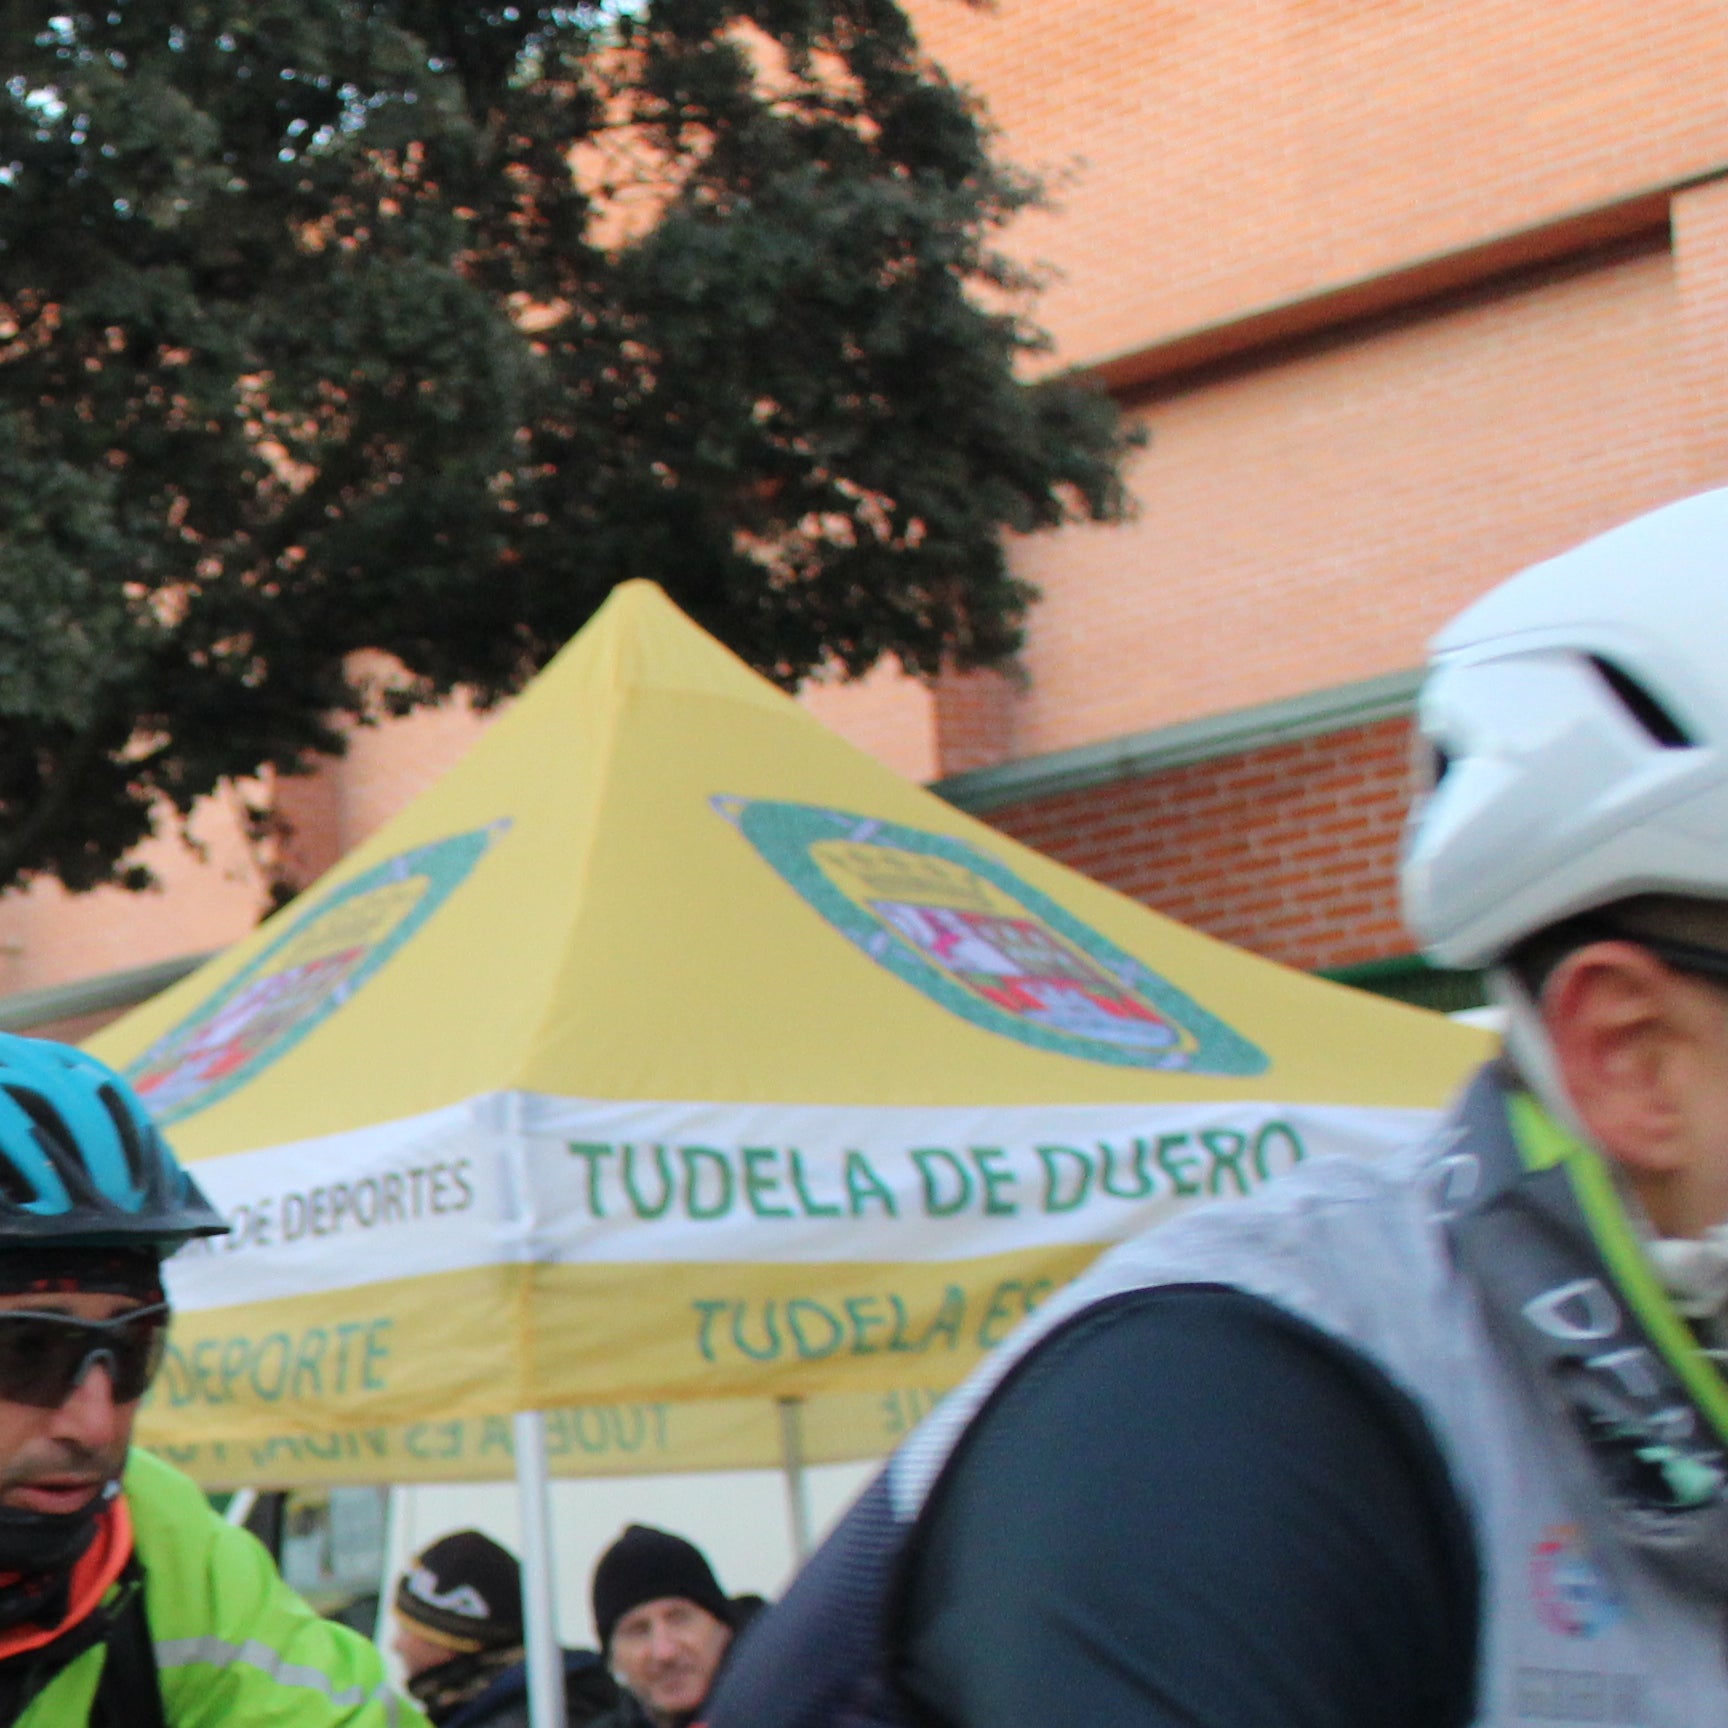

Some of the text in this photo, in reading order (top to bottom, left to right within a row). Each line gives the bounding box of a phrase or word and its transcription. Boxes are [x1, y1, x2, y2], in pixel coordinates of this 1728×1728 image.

[282, 1158, 474, 1243] DEPORTES
[568, 1120, 1306, 1220] TUDELA DE DUERO
[692, 1278, 964, 1362] TUDELA
